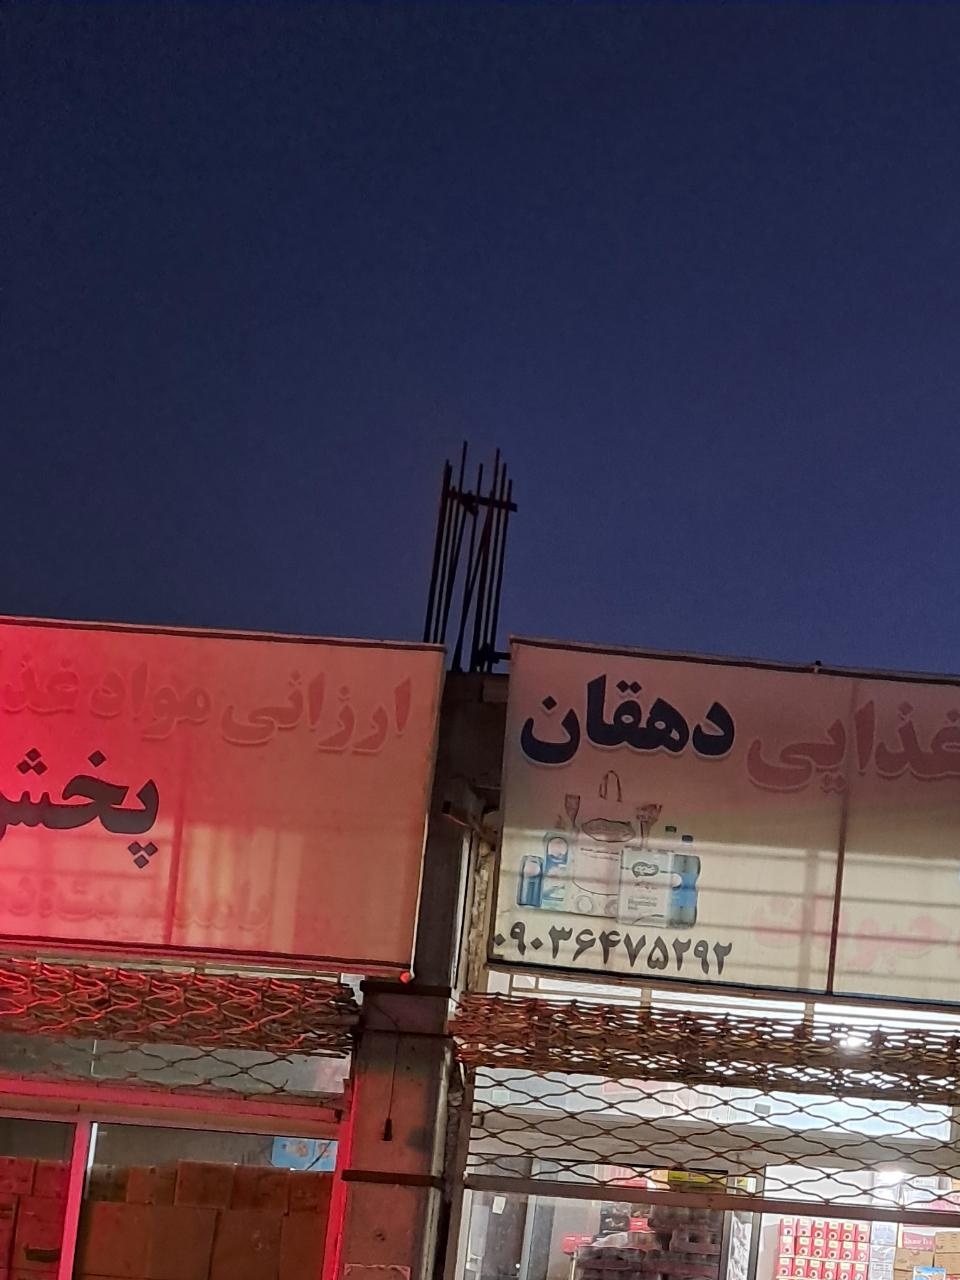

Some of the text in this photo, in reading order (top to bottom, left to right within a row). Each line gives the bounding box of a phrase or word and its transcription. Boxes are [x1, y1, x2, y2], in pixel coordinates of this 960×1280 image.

[0, 652, 412, 754] ارزانی مواد غذ
[520, 674, 736, 766] دهقان
[494, 920, 733, 975] ۰۹۰۳۶۴۷۵۲۹۲
